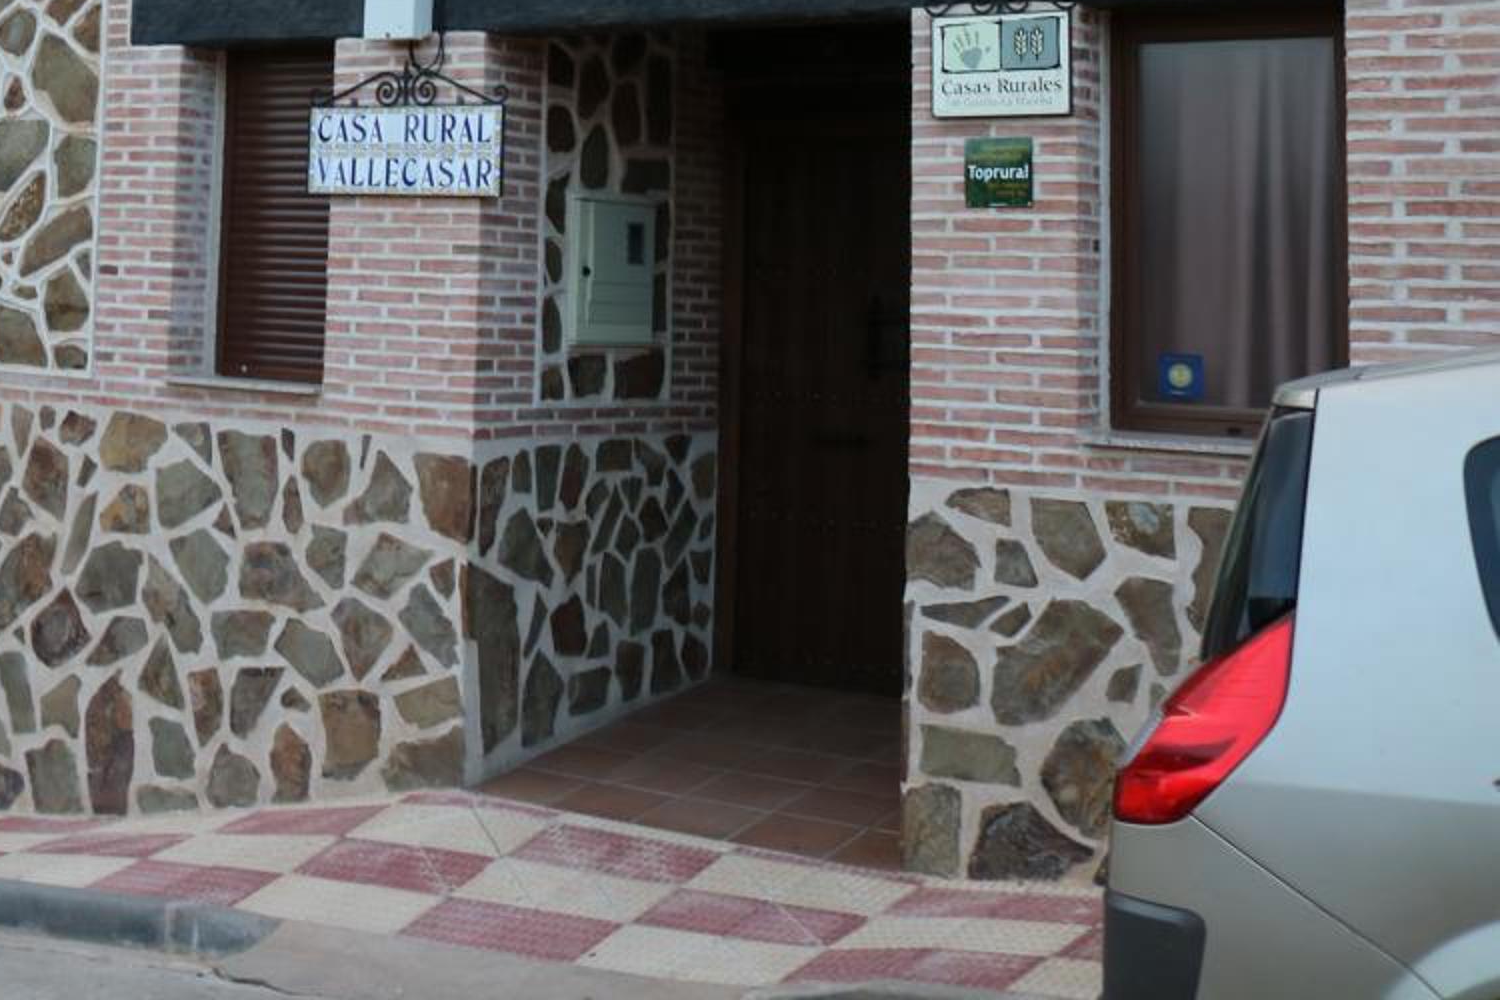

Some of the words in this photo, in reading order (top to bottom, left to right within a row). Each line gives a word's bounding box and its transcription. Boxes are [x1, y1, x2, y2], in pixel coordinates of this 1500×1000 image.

[941, 79, 991, 96] Casas
[998, 77, 1062, 94] Rurales
[317, 114, 383, 143] CASA
[404, 113, 491, 143] RURAL
[317, 157, 492, 188] VALLECASAR
[968, 164, 1028, 182] Toprural
